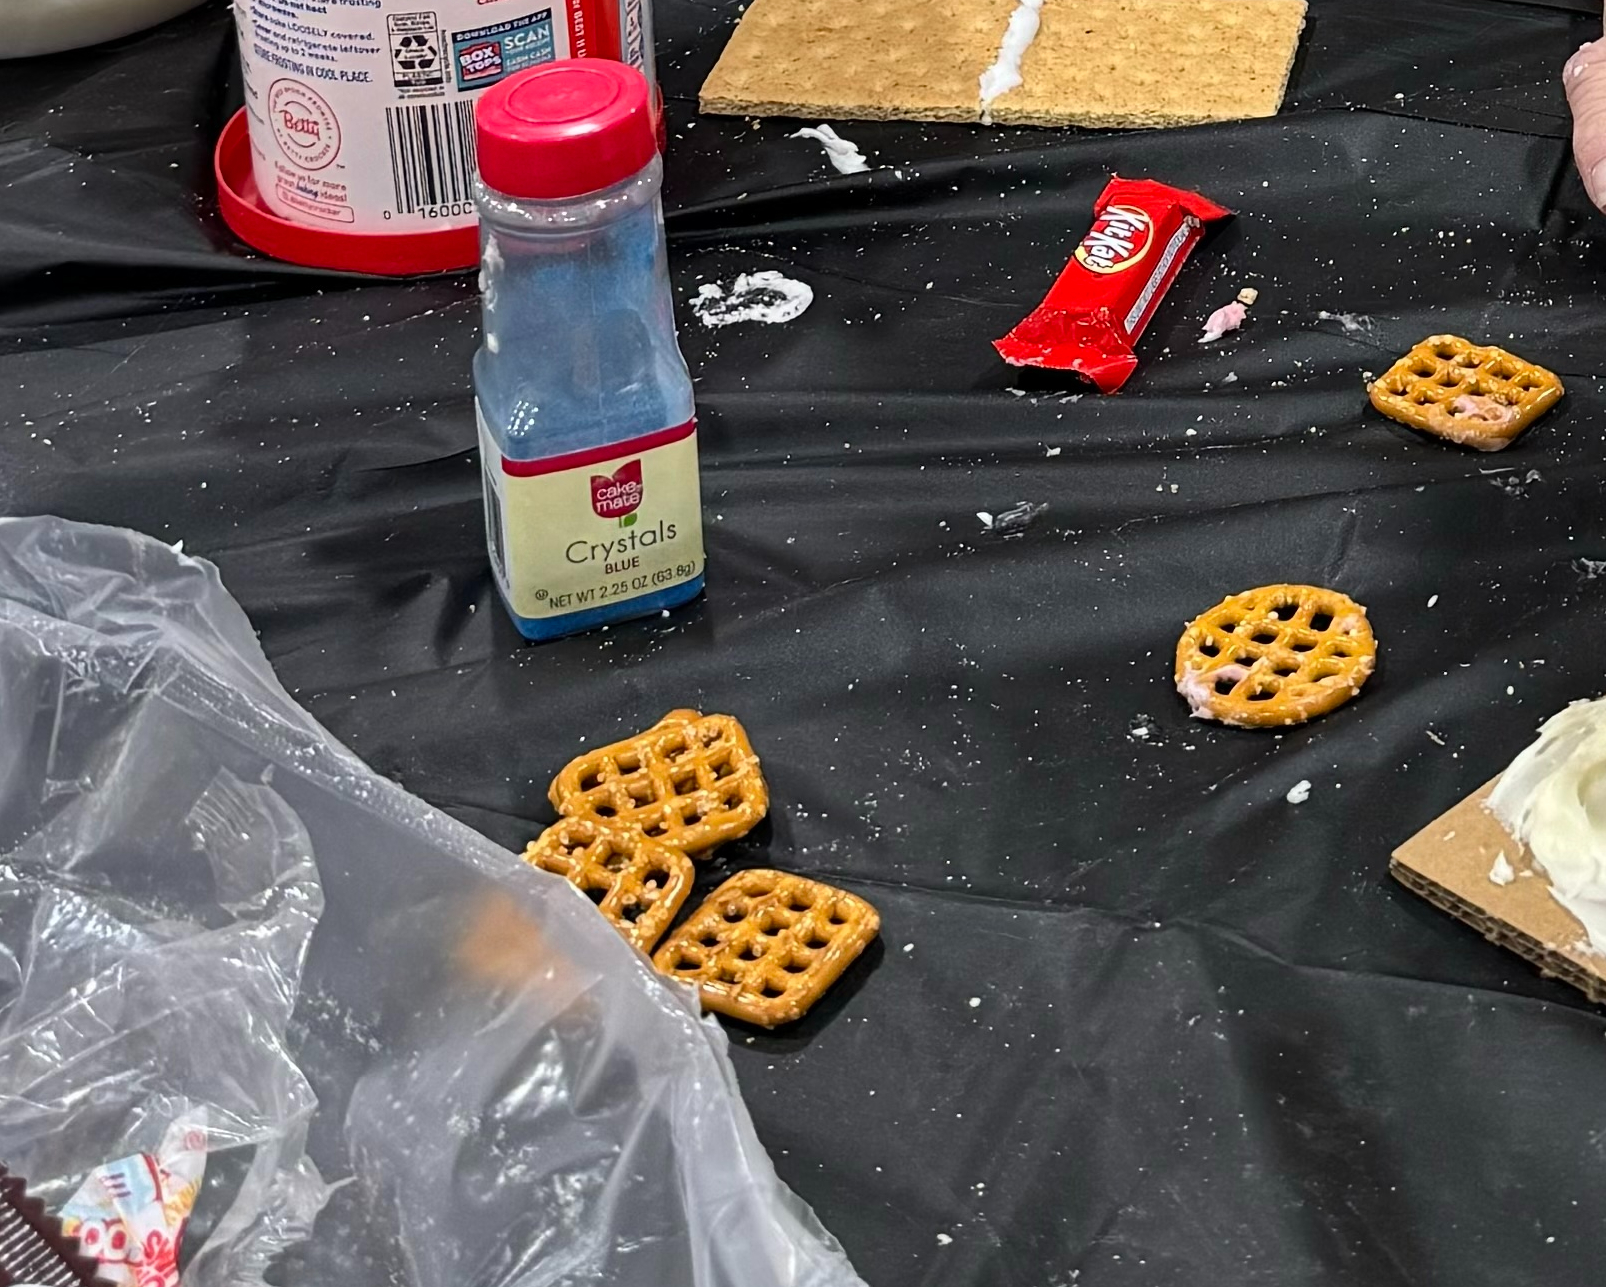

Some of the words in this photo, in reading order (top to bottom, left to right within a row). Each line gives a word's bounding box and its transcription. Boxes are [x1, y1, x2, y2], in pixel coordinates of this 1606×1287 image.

[287, 22, 328, 37] LOOSELY
[331, 32, 375, 41] covered.
[456, 22, 511, 41] DOWNLOAD
[513, 17, 529, 28] THE
[531, 11, 548, 23] APP
[339, 41, 381, 54] leftover
[504, 24, 550, 50] SCAN
[459, 46, 495, 65] BOX
[466, 57, 501, 73] TOPS
[340, 71, 373, 83] PLACE.
[279, 109, 321, 142] Betty
[383, 210, 391, 220] 0
[1100, 205, 1152, 238] Kit
[1083, 230, 1135, 269] Kat
[595, 492, 640, 513] mate
[565, 519, 677, 564] Crystals
[604, 555, 640, 575] BLUE
[549, 594, 572, 610] NET
[576, 588, 596, 604] WT
[600, 581, 628, 599] 2.25
[632, 575, 649, 591] OZ
[651, 560, 696, 586] (63.8g)
